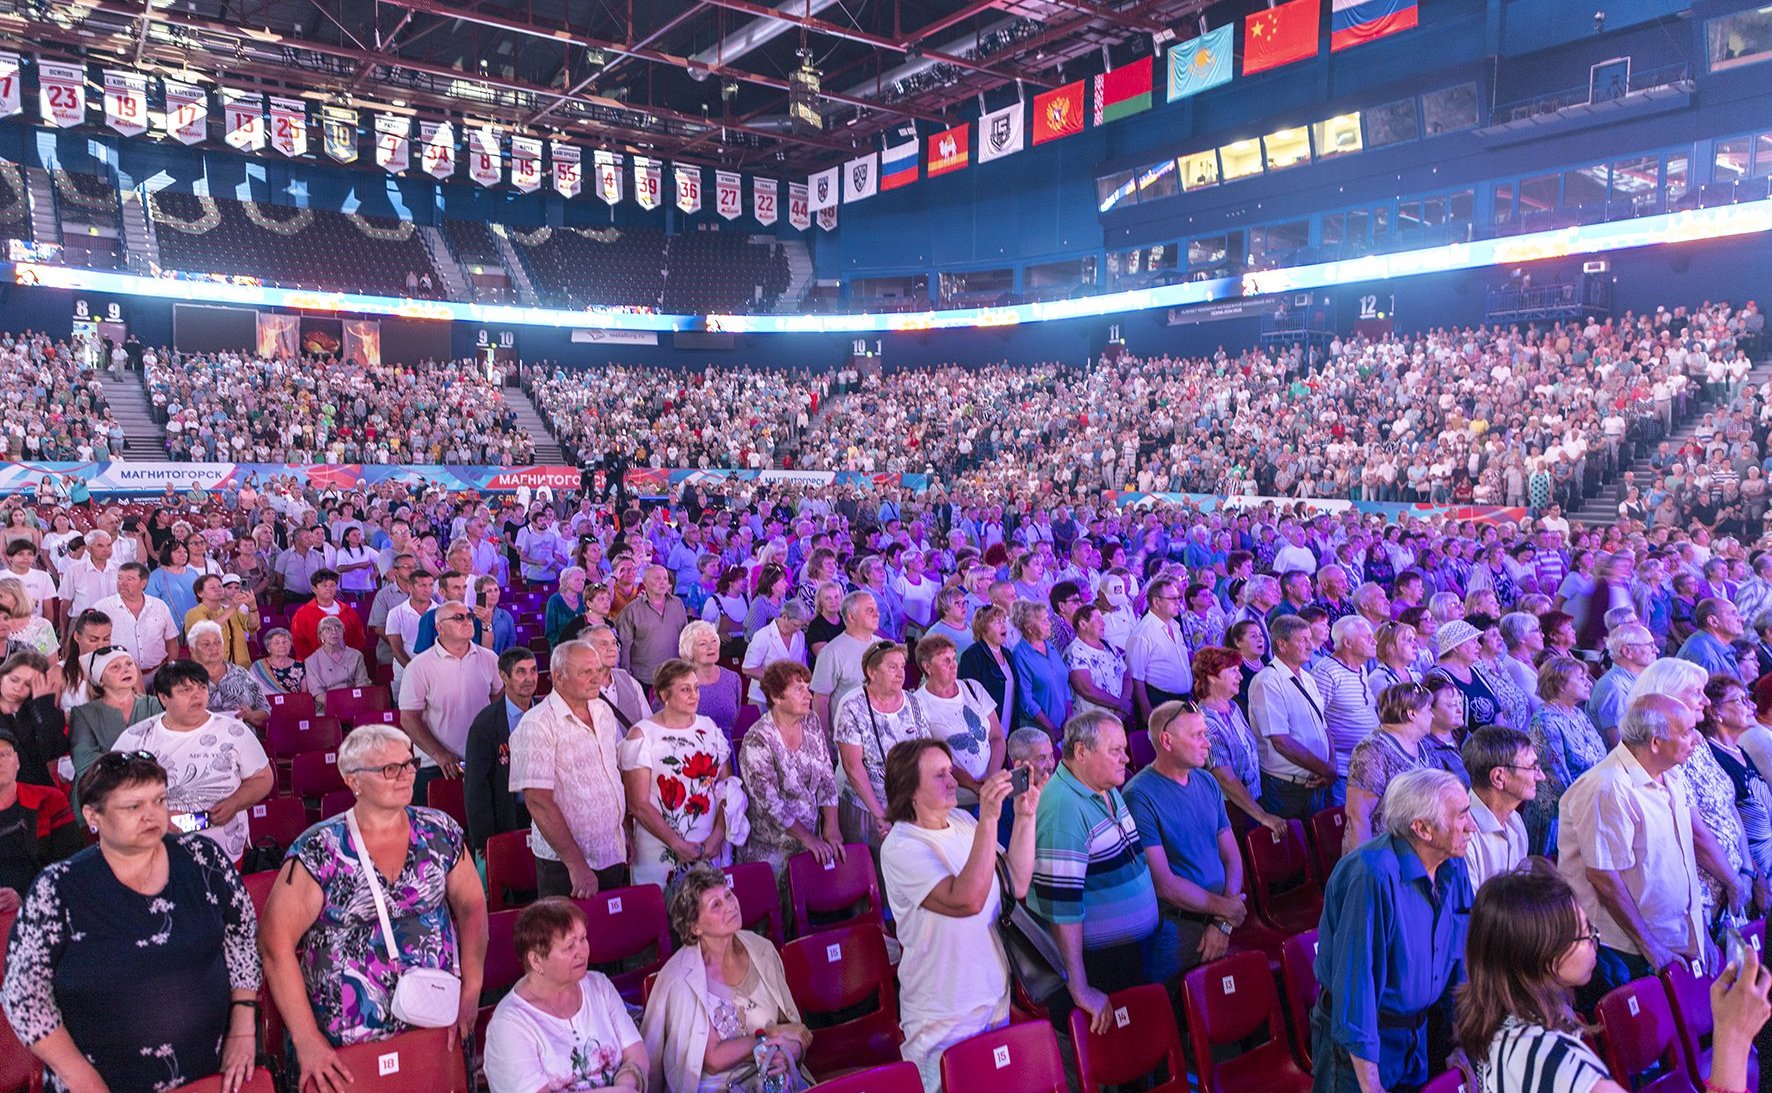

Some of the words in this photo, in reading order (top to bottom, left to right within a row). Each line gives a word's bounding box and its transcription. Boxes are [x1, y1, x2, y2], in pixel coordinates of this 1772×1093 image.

[49, 85, 77, 109] 23
[116, 95, 137, 117] 19
[178, 104, 197, 127] 17
[236, 113, 254, 133] 13
[333, 125, 350, 146] 10
[388, 137, 397, 156] 7
[428, 145, 448, 163] 34
[481, 153, 491, 170] 8
[519, 159, 534, 177] 15
[558, 163, 576, 182] 55
[605, 172, 613, 188] 4
[640, 176, 657, 195] 39
[680, 181, 697, 199] 36
[721, 189, 737, 206] 27
[758, 195, 771, 212] 22
[792, 200, 808, 217] 44
[76, 299, 89, 317] 8
[108, 302, 121, 319] 9
[1359, 294, 1377, 315] 12
[478, 330, 488, 344] 9
[499, 331, 514, 346] 10
[1109, 324, 1119, 340] 11
[852, 338, 866, 353] 10
[120, 470, 223, 480] МАГНИТОГОРСК
[499, 474, 607, 485] МАГНИТОГОСК
[611, 901, 620, 911] 16
[829, 949, 839, 958] 15
[382, 1058, 395, 1070] 18
[996, 1051, 1006, 1063] 15
